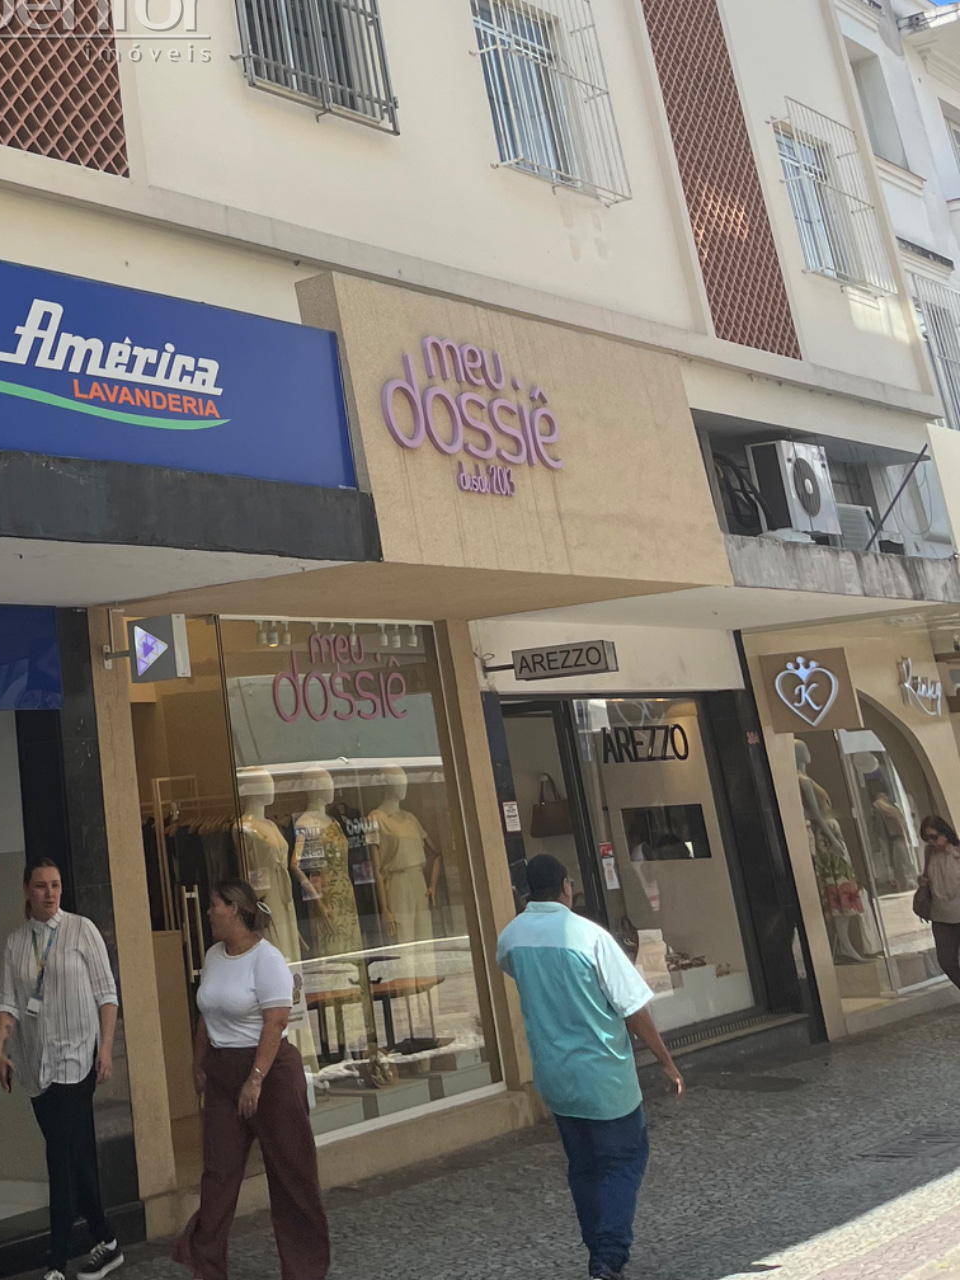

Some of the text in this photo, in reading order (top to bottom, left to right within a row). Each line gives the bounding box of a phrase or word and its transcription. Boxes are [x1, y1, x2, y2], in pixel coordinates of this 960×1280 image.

[422, 335, 505, 390] meu
[73, 379, 220, 418] LAVANDERIA
[381, 352, 564, 470] dossiê
[309, 634, 364, 663] meu
[519, 646, 602, 674] AREZZO
[272, 650, 409, 722] dossiê
[794, 683, 824, 710] K
[602, 724, 689, 764] AREZZO
